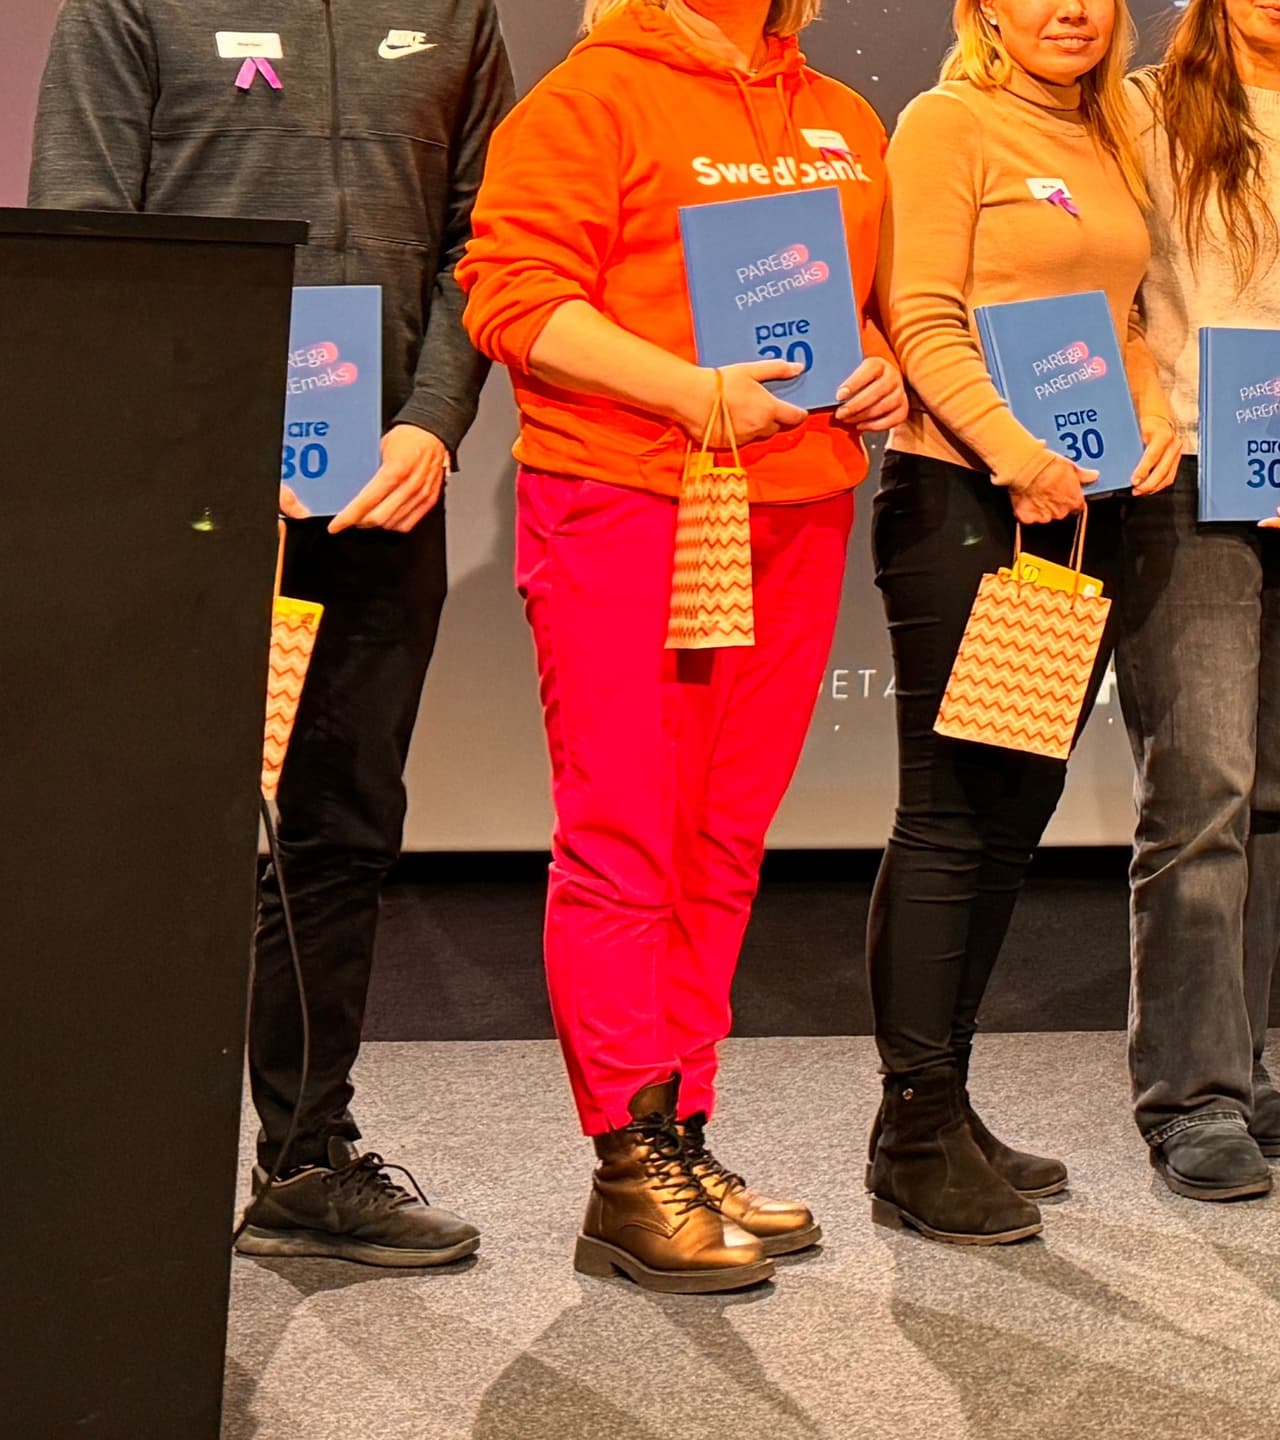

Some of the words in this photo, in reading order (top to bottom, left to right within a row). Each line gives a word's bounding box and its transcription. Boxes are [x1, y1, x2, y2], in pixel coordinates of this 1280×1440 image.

[736, 249, 801, 284] PAREga
[735, 267, 823, 310] PAREmaks
[755, 319, 811, 344] pare
[1032, 346, 1083, 377] PAREga
[1034, 360, 1101, 401] PAREmaks
[1054, 409, 1098, 431] pare
[1061, 428, 1105, 462] 30
